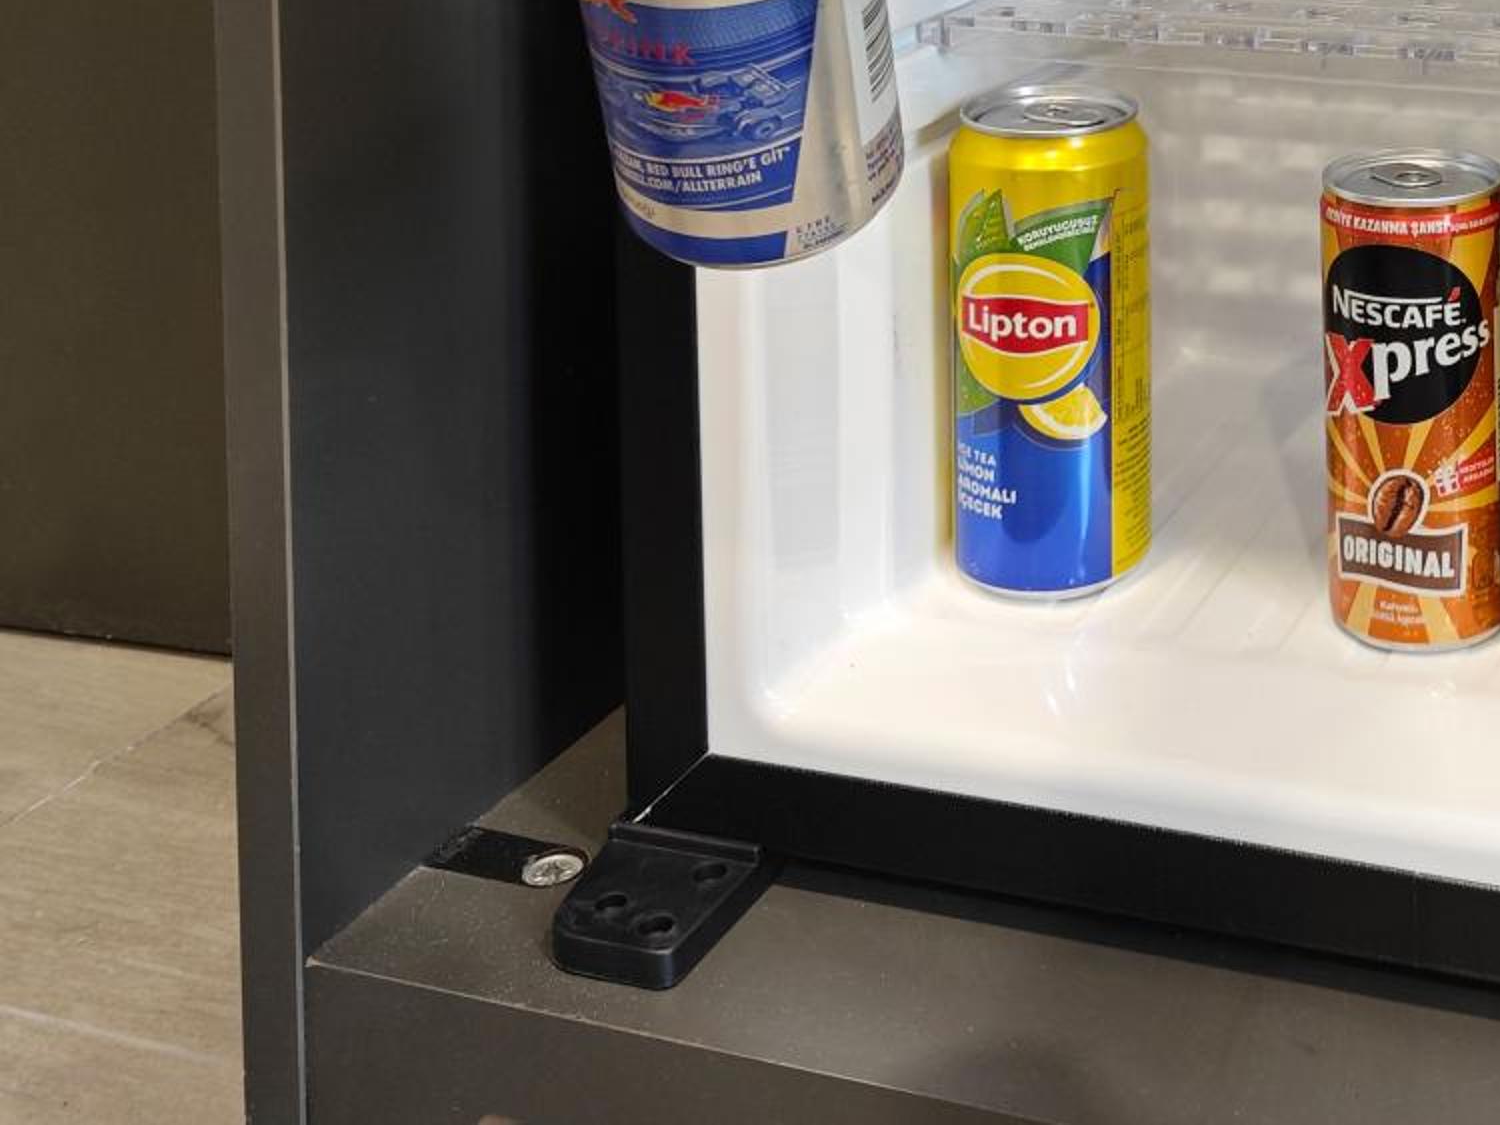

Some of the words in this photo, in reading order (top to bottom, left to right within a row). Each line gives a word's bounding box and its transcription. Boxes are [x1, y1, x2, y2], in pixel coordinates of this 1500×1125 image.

[671, 164, 703, 178] BULL
[1353, 216, 1409, 235] KAZANMA
[968, 301, 1078, 341] Lipton
[1332, 284, 1463, 328] NESCAFÉ
[1325, 319, 1490, 416] Xpress
[974, 450, 997, 467] TEA
[1343, 535, 1455, 578] ORIGINAL
